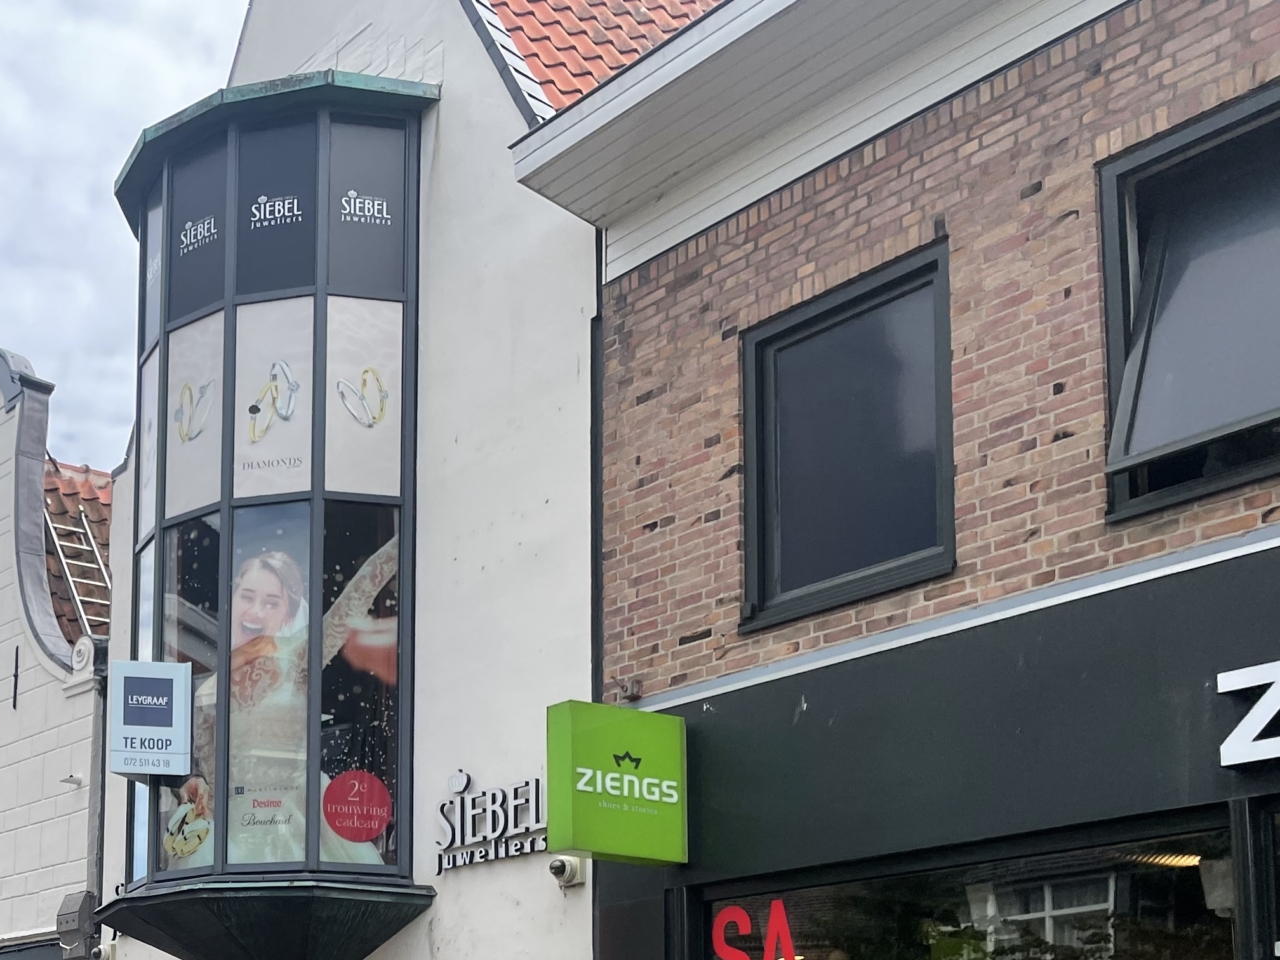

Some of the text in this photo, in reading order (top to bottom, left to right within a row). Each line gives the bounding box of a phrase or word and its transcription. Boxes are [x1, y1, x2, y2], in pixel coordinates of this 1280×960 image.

[251, 199, 302, 220] SIEBEL
[341, 197, 391, 218] SIEBEL
[180, 218, 217, 248] SIEBEL
[243, 457, 302, 470] DIAMONDS
[128, 695, 168, 705] LEYGRAAF
[123, 737, 172, 750] TE KOOP
[124, 758, 170, 768] 072 511 43 18
[576, 767, 678, 804] ZIENGS
[327, 803, 388, 818] trouwring
[622, 803, 629, 811] &
[435, 778, 547, 851] SIEBEL
[335, 815, 379, 829] cadeau
